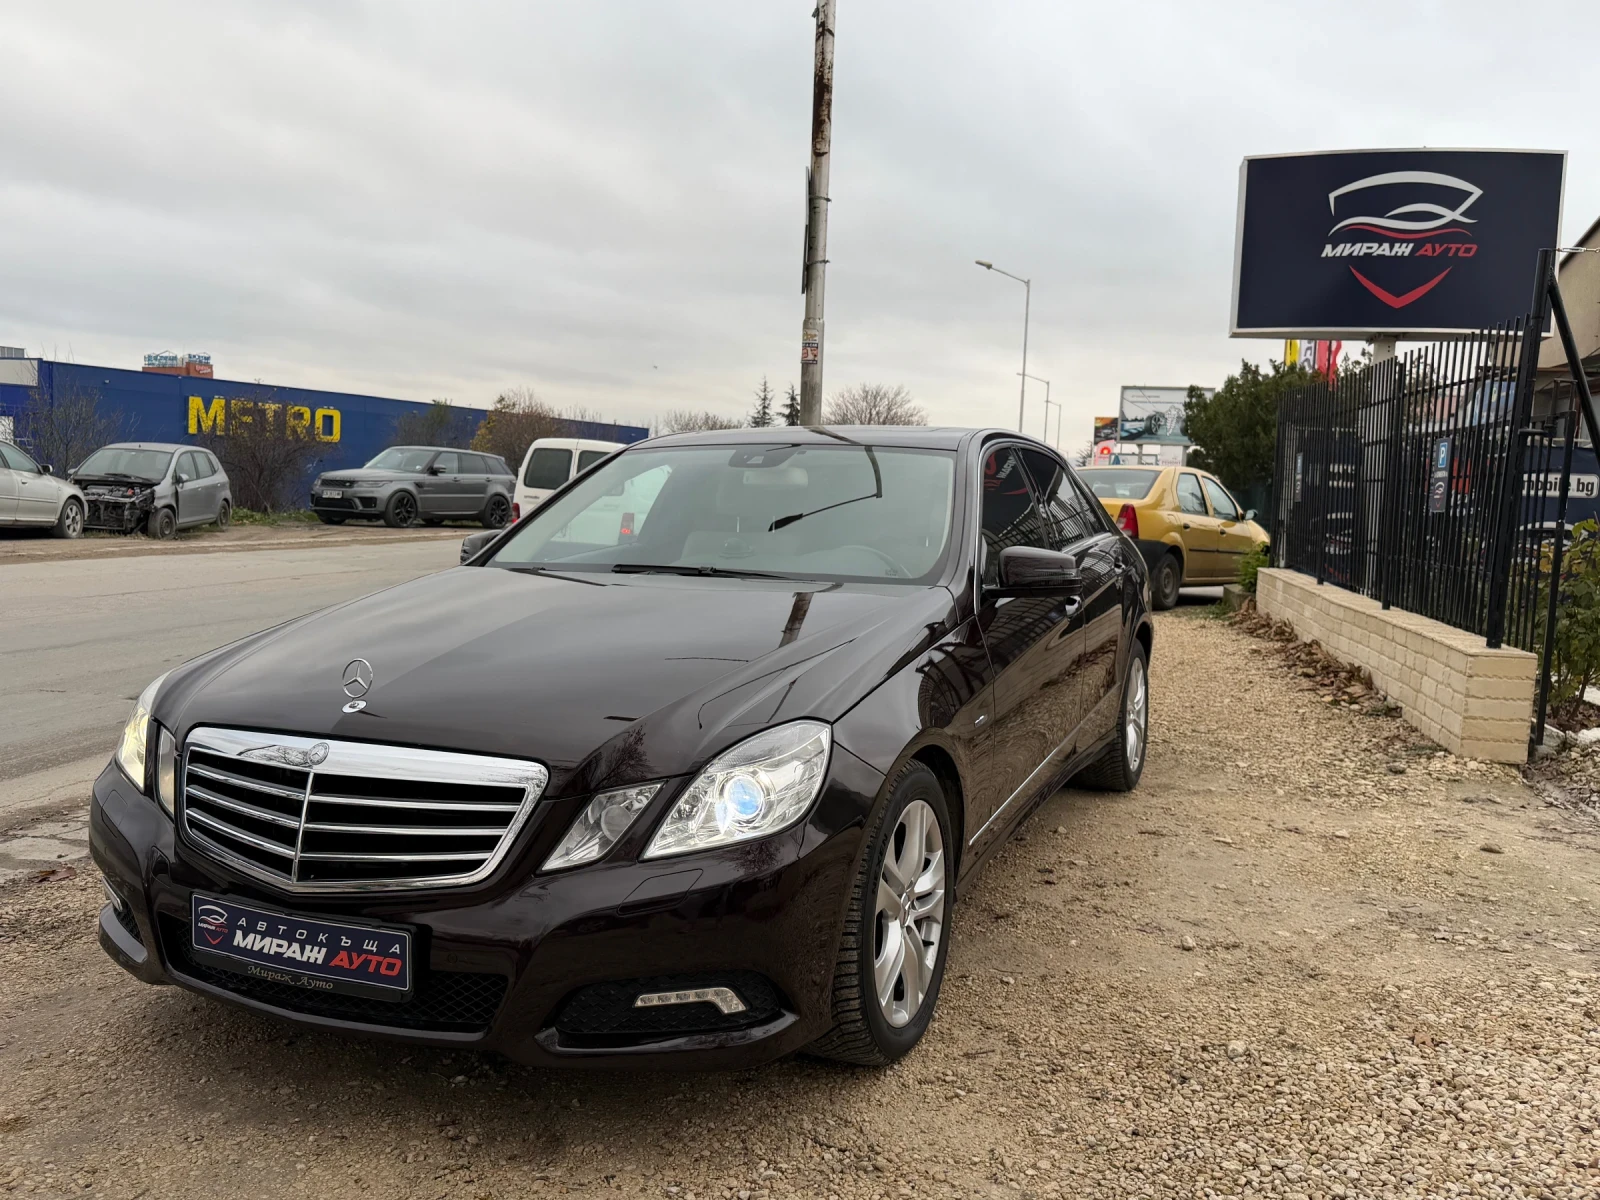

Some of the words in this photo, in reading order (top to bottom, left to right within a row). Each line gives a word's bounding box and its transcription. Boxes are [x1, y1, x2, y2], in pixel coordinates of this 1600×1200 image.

[1321, 243, 1414, 257] МИРАЖ
[1415, 243, 1478, 257] АУТО
[188, 395, 341, 442] METRO
[872, 833, 888, 895] NEXEN
[233, 929, 328, 965] МИРАЖ
[328, 950, 403, 977] АУТО
[247, 965, 295, 985] Мираж
[296, 976, 334, 989] Ауто
